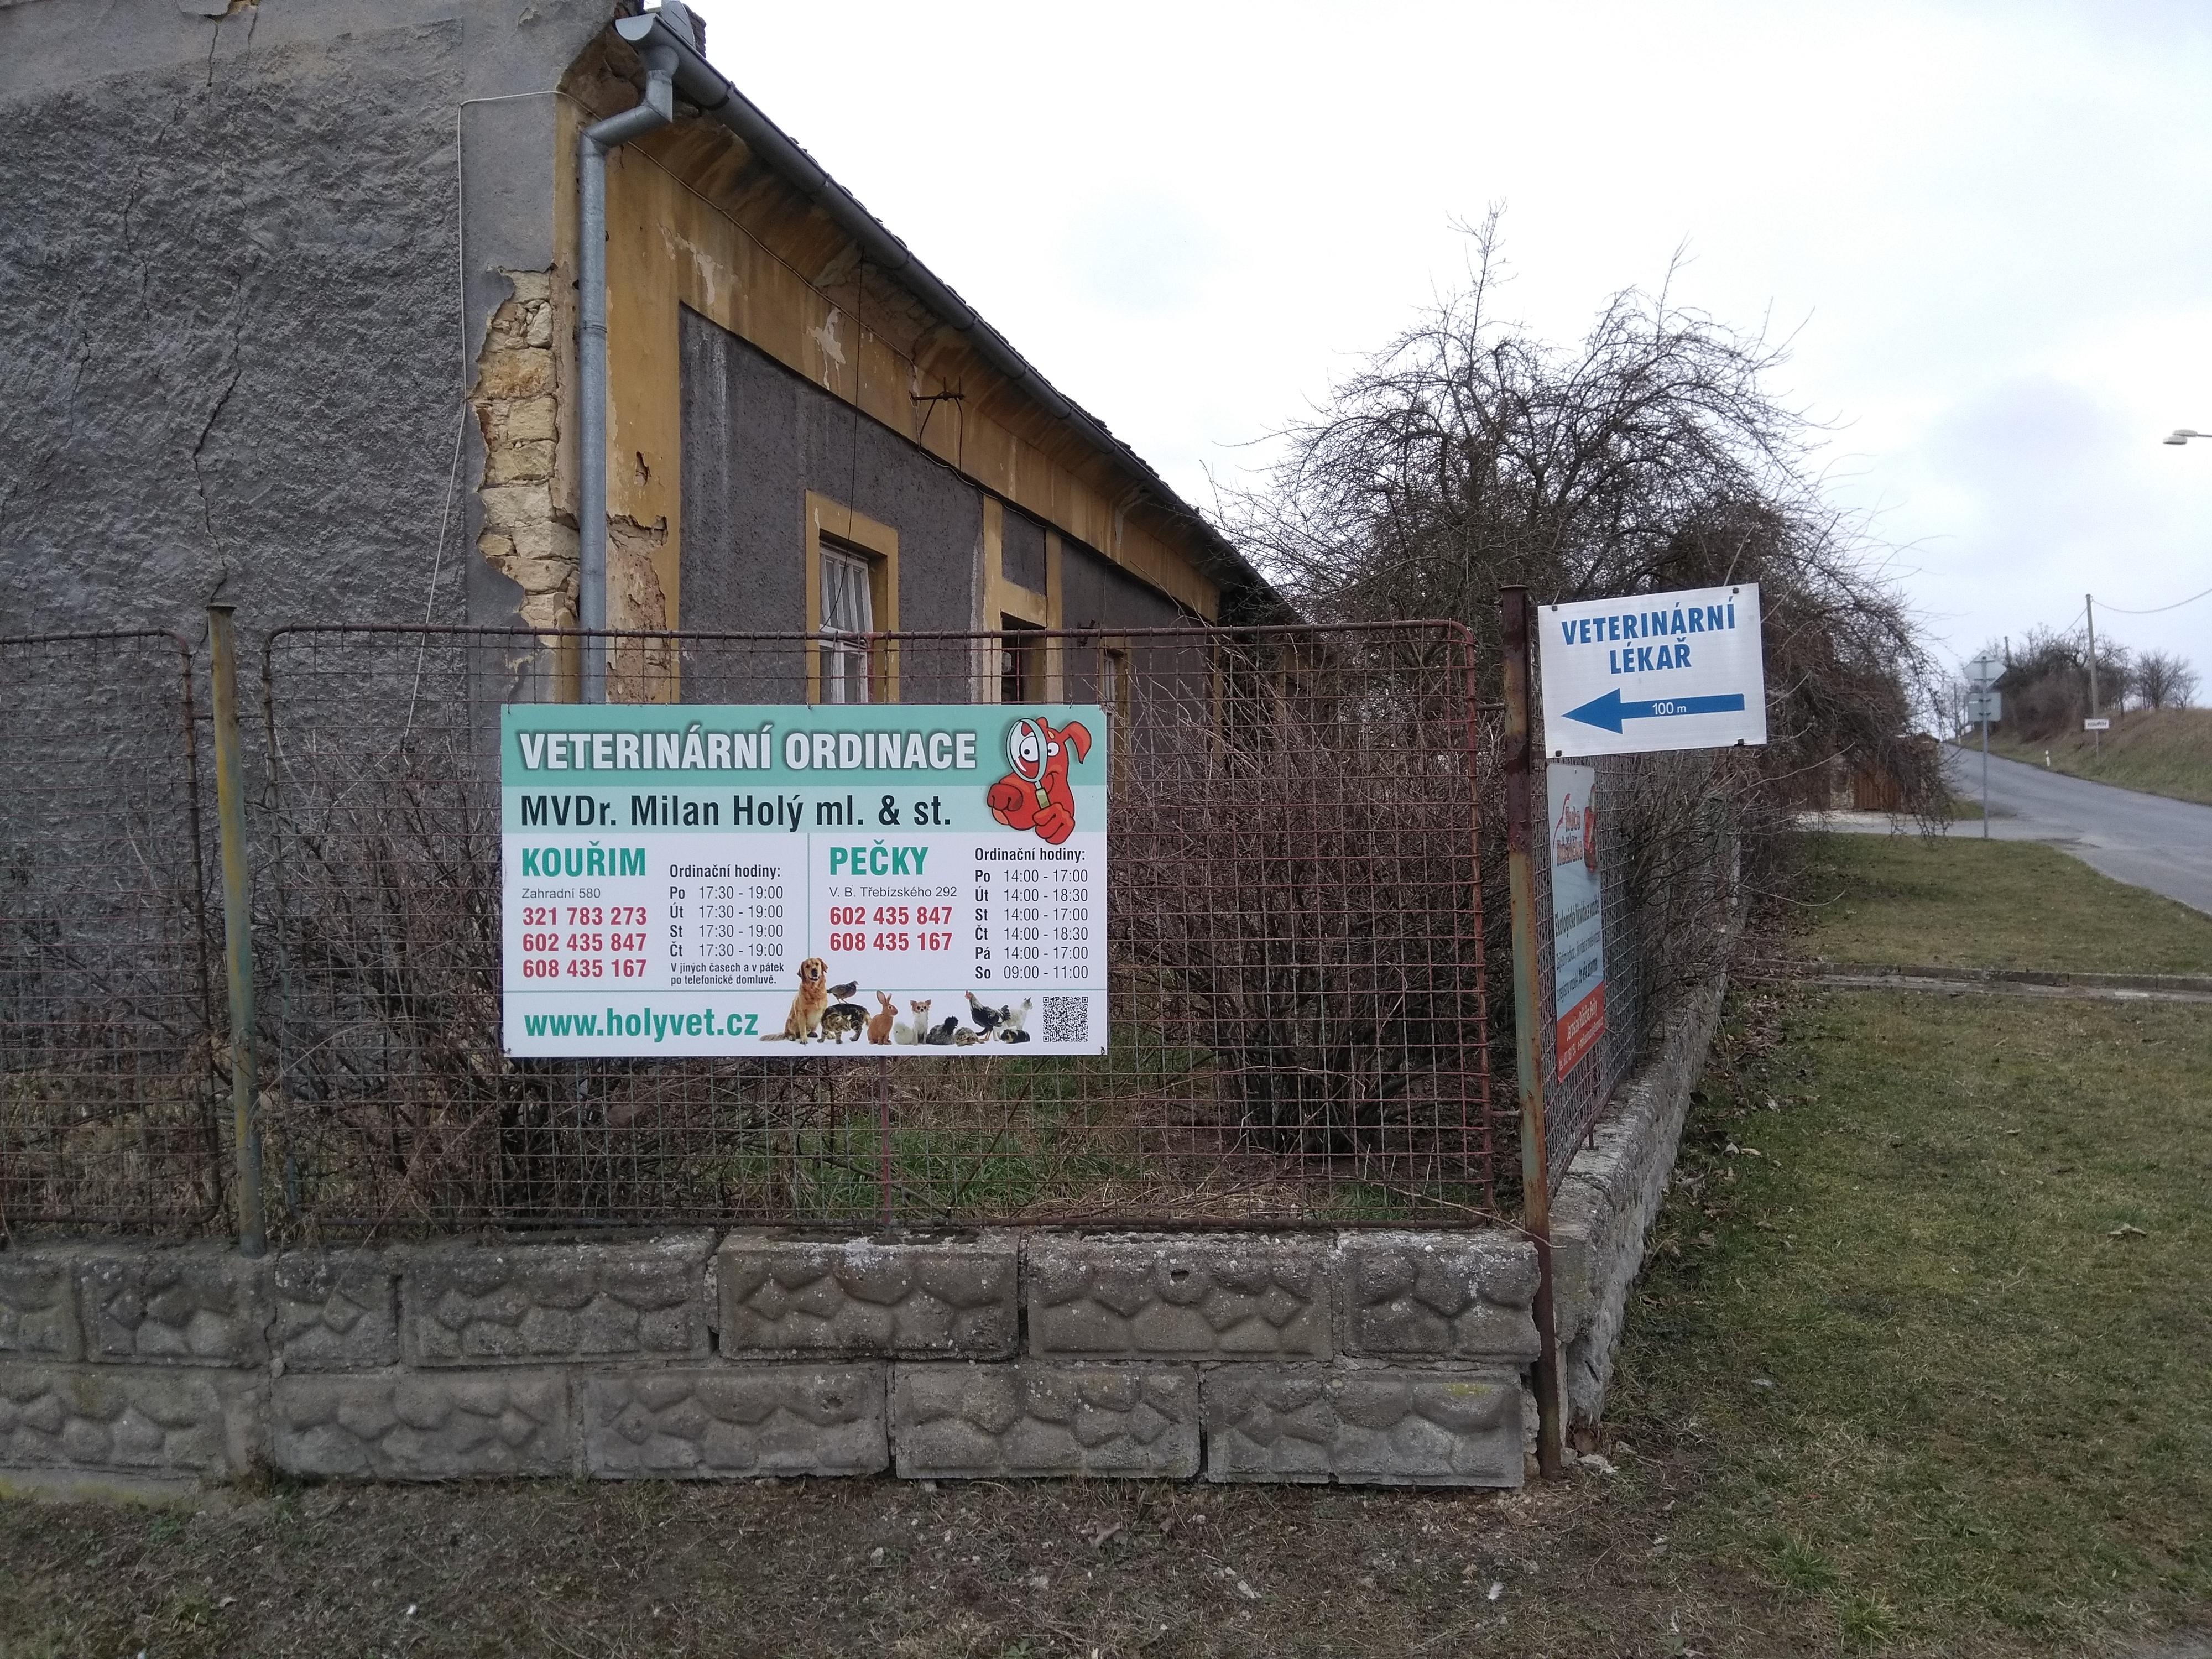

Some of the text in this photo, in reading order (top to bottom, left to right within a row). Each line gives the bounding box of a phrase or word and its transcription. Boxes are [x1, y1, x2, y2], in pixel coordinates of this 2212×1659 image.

[1561, 596, 1735, 645] VETERINÁRNÍ
[1610, 637, 1692, 674] LÉKAŘ
[1652, 702, 1673, 715] 100
[520, 725, 975, 769] VETERINÁRNÍ ORDINACE
[521, 794, 951, 833] MVDr. Milan Holý ml. & st.
[522, 840, 646, 877] KOUŘIM
[830, 839, 929, 876] PEČKY
[975, 847, 1085, 863] Ordinační hodiny:
[670, 864, 780, 880] Ordinační hodiny:
[975, 869, 990, 883] Po
[1004, 869, 1039, 883] 14:00
[1053, 869, 1088, 883] 17:00
[521, 888, 601, 899] Zahradní 580
[670, 886, 685, 899] Po
[698, 885, 734, 899] 17:30
[748, 885, 783, 899] 19:00
[829, 886, 957, 898] V. B. Třebízského 292
[975, 885, 989, 902] Út
[1004, 889, 1039, 902] 14:00
[1053, 888, 1088, 902] 18:30
[523, 906, 647, 926] 321 783 273
[670, 902, 684, 919] Út
[698, 905, 734, 919] 17:30
[748, 905, 783, 919] 19:00
[830, 906, 952, 925] 602 435 847
[975, 907, 988, 921] St
[1004, 907, 1039, 921] 14:00
[1053, 907, 1088, 921] 17:00
[1554, 905, 1575, 938] Ekologická
[670, 924, 683, 938] St
[699, 924, 734, 938] 17:30
[748, 924, 783, 937] 19:00
[975, 924, 988, 941] Čt
[1004, 927, 1039, 941] 14:00
[1053, 927, 1088, 940] 18:30
[523, 933, 646, 952] 602 435 847
[670, 941, 683, 957] Čt
[699, 943, 734, 957] 17:30
[748, 943, 784, 957] 19:00
[830, 932, 952, 951] 608 435 167
[975, 946, 990, 960] Pá
[1004, 946, 1039, 959] 14:00
[1053, 946, 1088, 959] 17:00
[523, 959, 646, 978] 608 435 167
[670, 962, 677, 972] V
[679, 962, 706, 974] jiných
[709, 962, 740, 972] časech
[760, 962, 784, 974] pátek
[975, 966, 991, 979] So
[1004, 966, 1039, 979] 09:00
[1053, 966, 1088, 979] 11:00
[671, 974, 776, 987] po telefonické domluvě.
[524, 1007, 758, 1043] www.holyvet.cz
